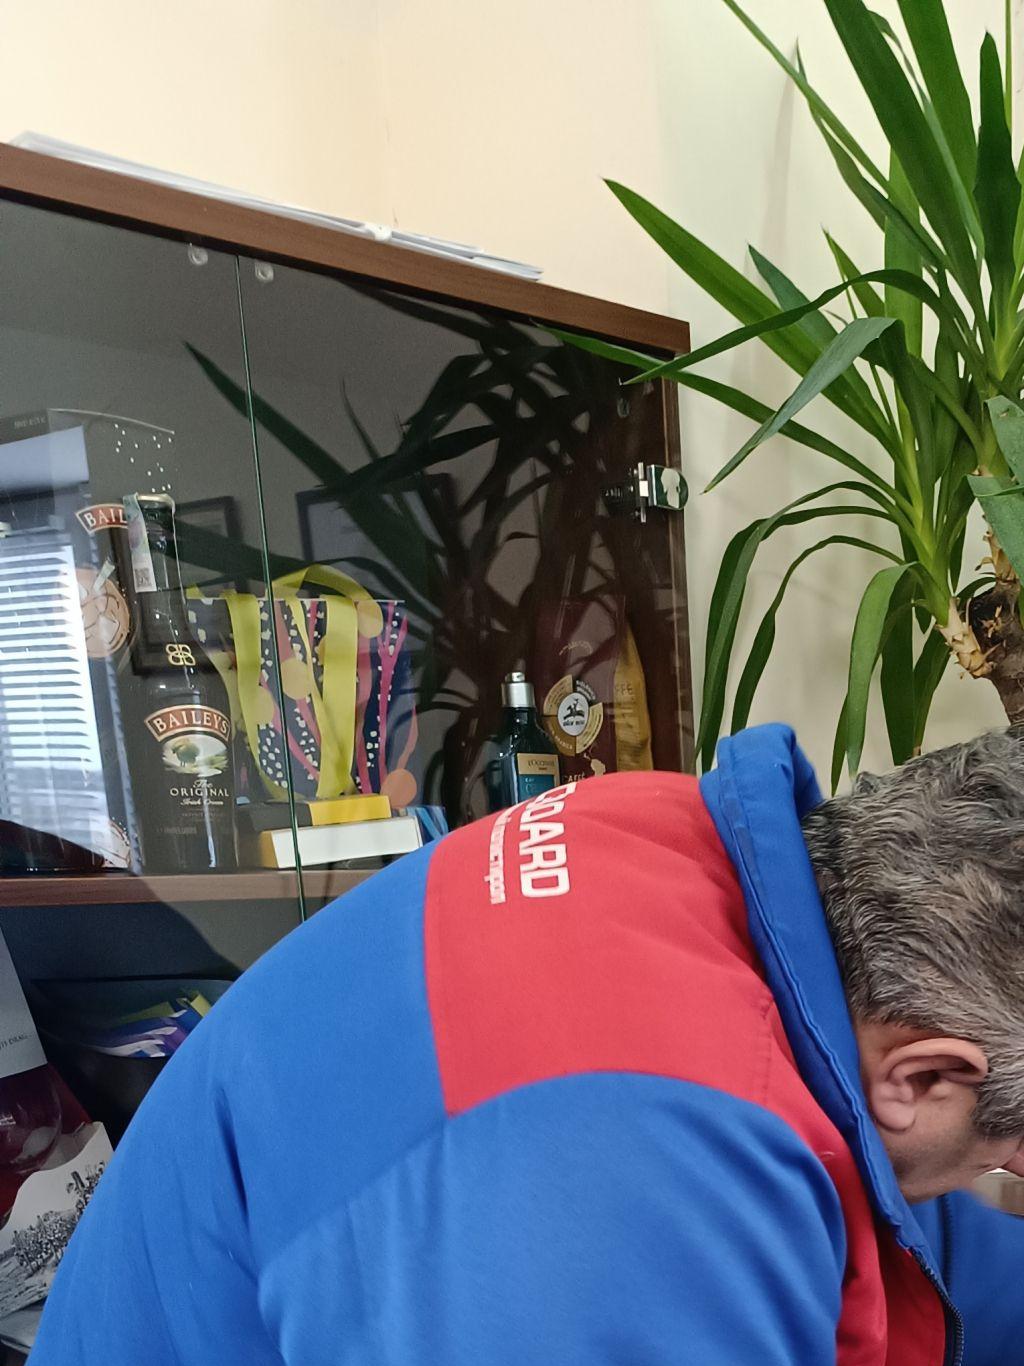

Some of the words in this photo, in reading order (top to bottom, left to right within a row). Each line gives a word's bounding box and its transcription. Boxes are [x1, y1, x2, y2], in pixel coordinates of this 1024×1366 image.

[84, 509, 128, 527] BAIL
[153, 710, 227, 733] BAILEYS
[170, 787, 229, 797] ORIGINAL
